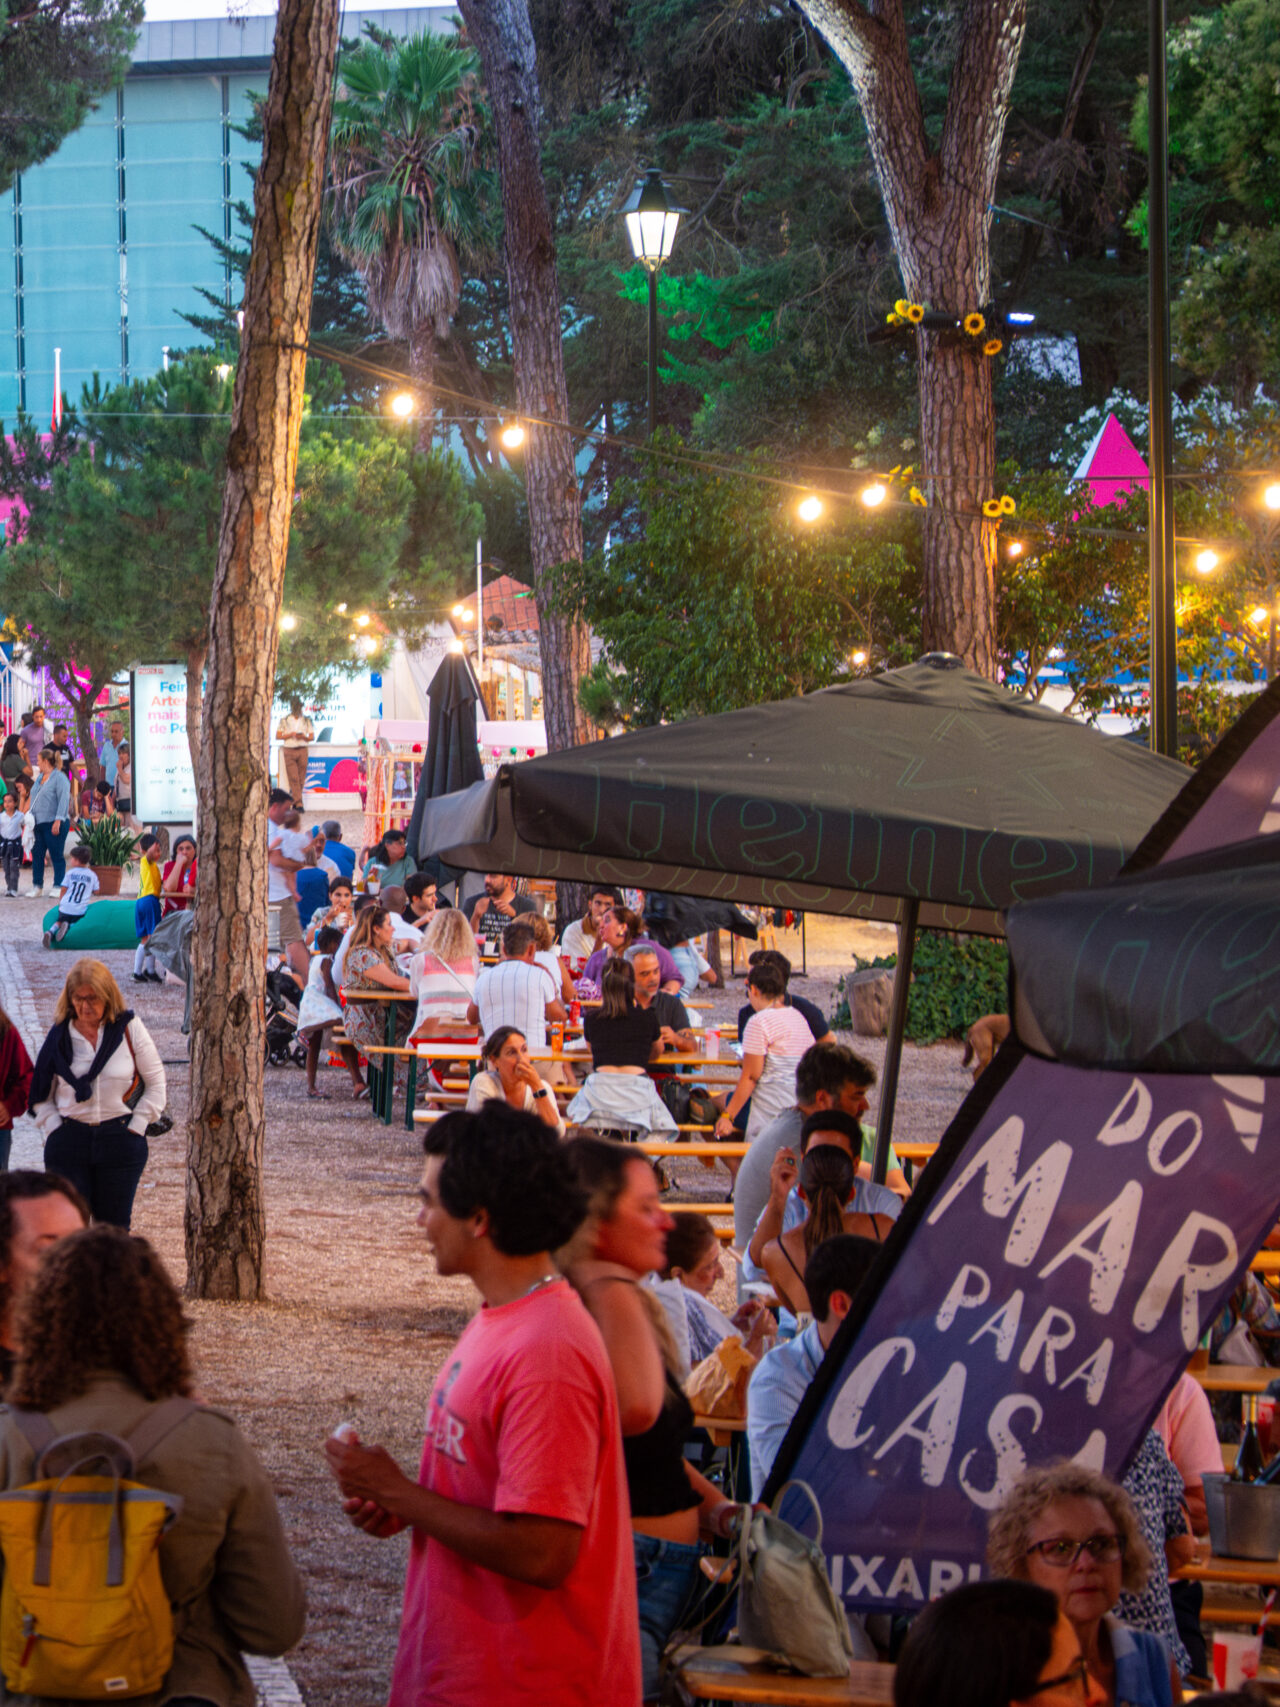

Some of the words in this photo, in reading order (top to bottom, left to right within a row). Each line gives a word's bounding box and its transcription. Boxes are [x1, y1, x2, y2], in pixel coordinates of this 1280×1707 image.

[68, 881, 87, 904] 10
[1096, 1077, 1203, 1177] DO
[927, 1114, 1240, 1352] MAR
[935, 1263, 1114, 1407] PARA
